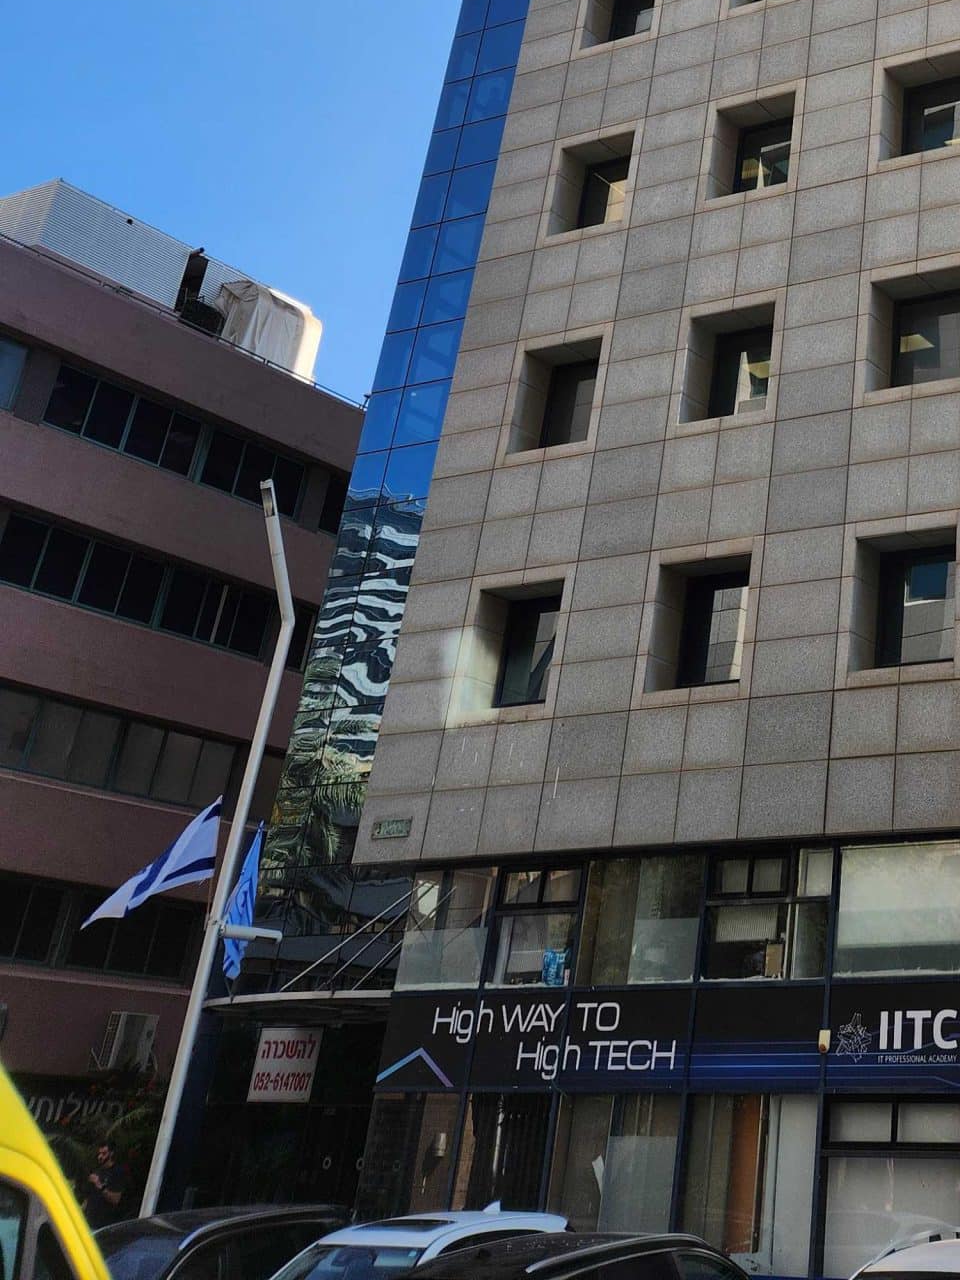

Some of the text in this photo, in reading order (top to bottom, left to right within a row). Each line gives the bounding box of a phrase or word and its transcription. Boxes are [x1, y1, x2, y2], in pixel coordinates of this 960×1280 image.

[432, 1000, 621, 1044] High WAY TO
[879, 1009, 958, 1050] IITC
[261, 1033, 317, 1059] להשכרה
[516, 1036, 677, 1080] High TECH
[884, 1055, 927, 1063] PROFESSIONAL
[928, 1054, 958, 1063] ACADEMY
[253, 1072, 312, 1092] 052-6147007
